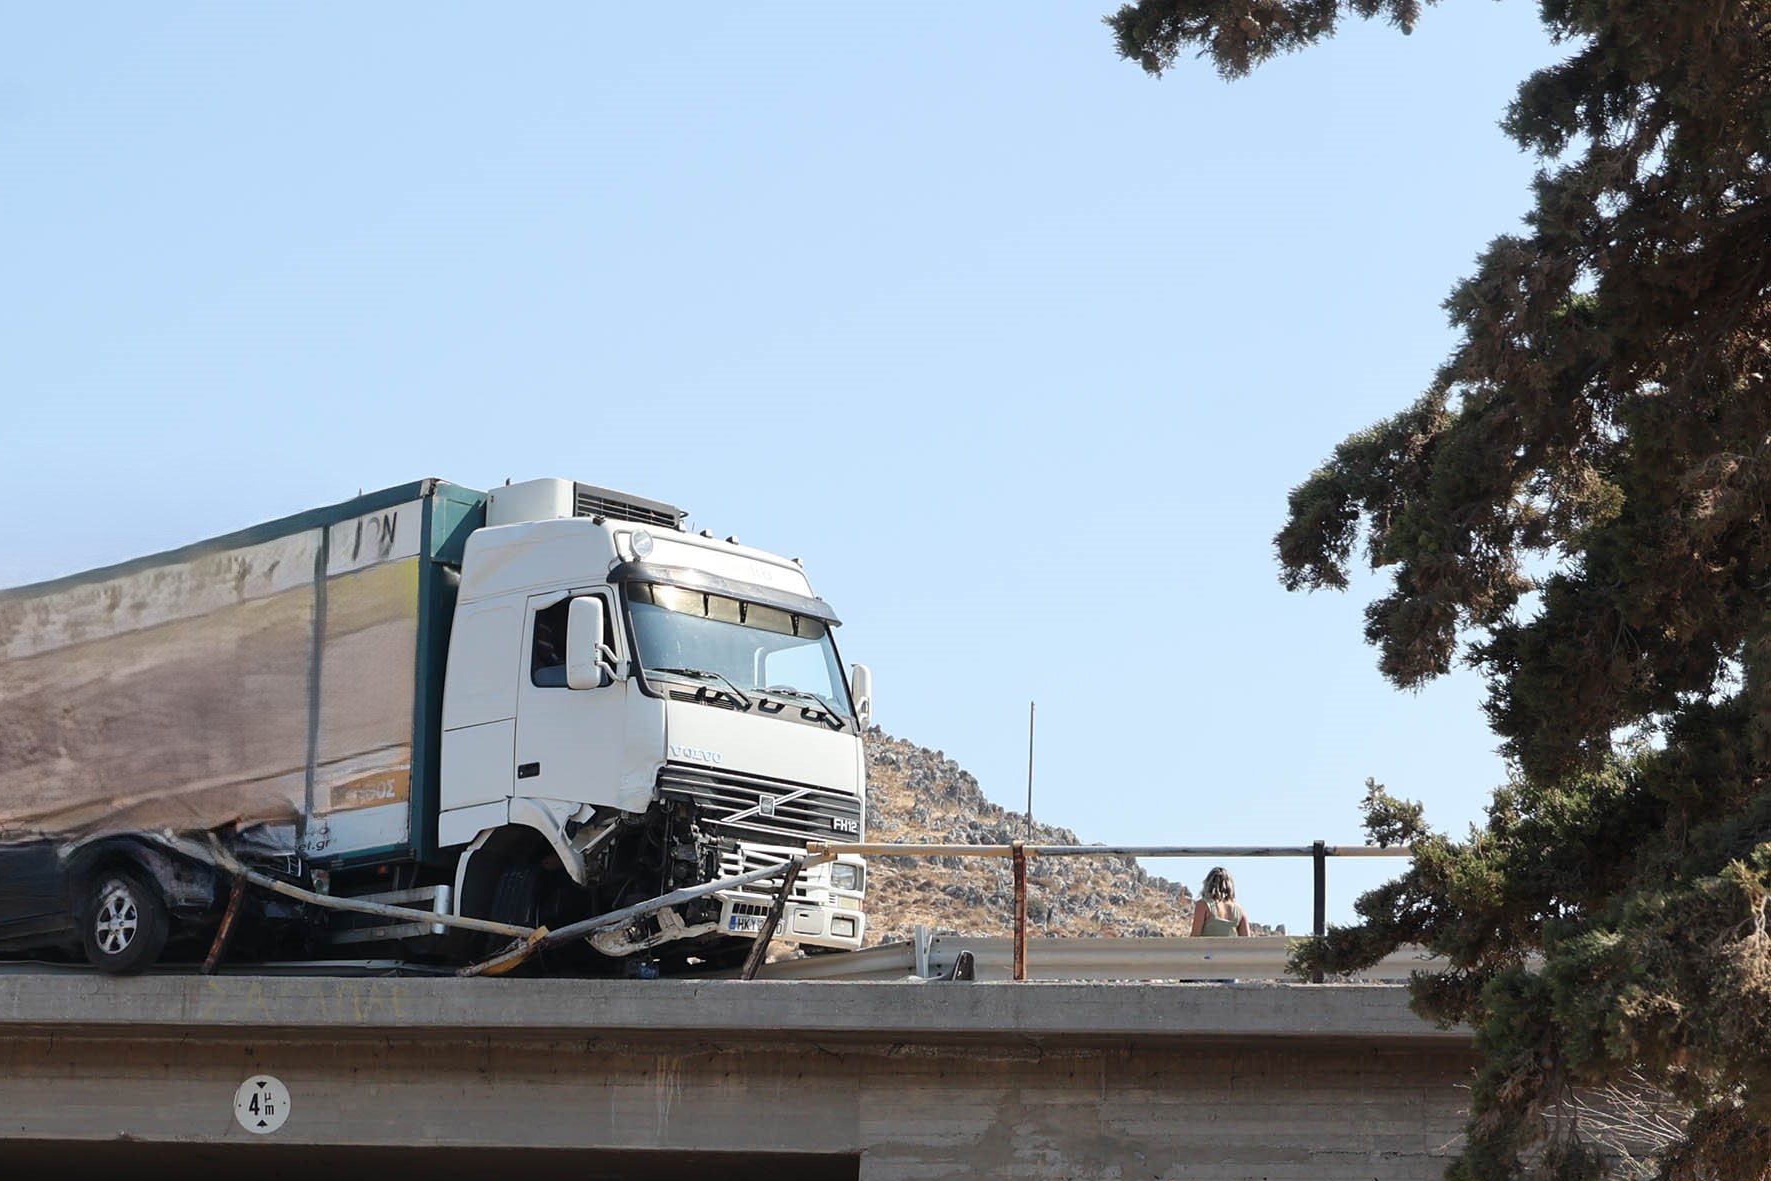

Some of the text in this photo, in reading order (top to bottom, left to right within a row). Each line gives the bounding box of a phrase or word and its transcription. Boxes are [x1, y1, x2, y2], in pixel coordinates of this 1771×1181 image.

[669, 744, 724, 763] VOLVO
[833, 818, 858, 833] FH12
[249, 1093, 260, 1116] 4
